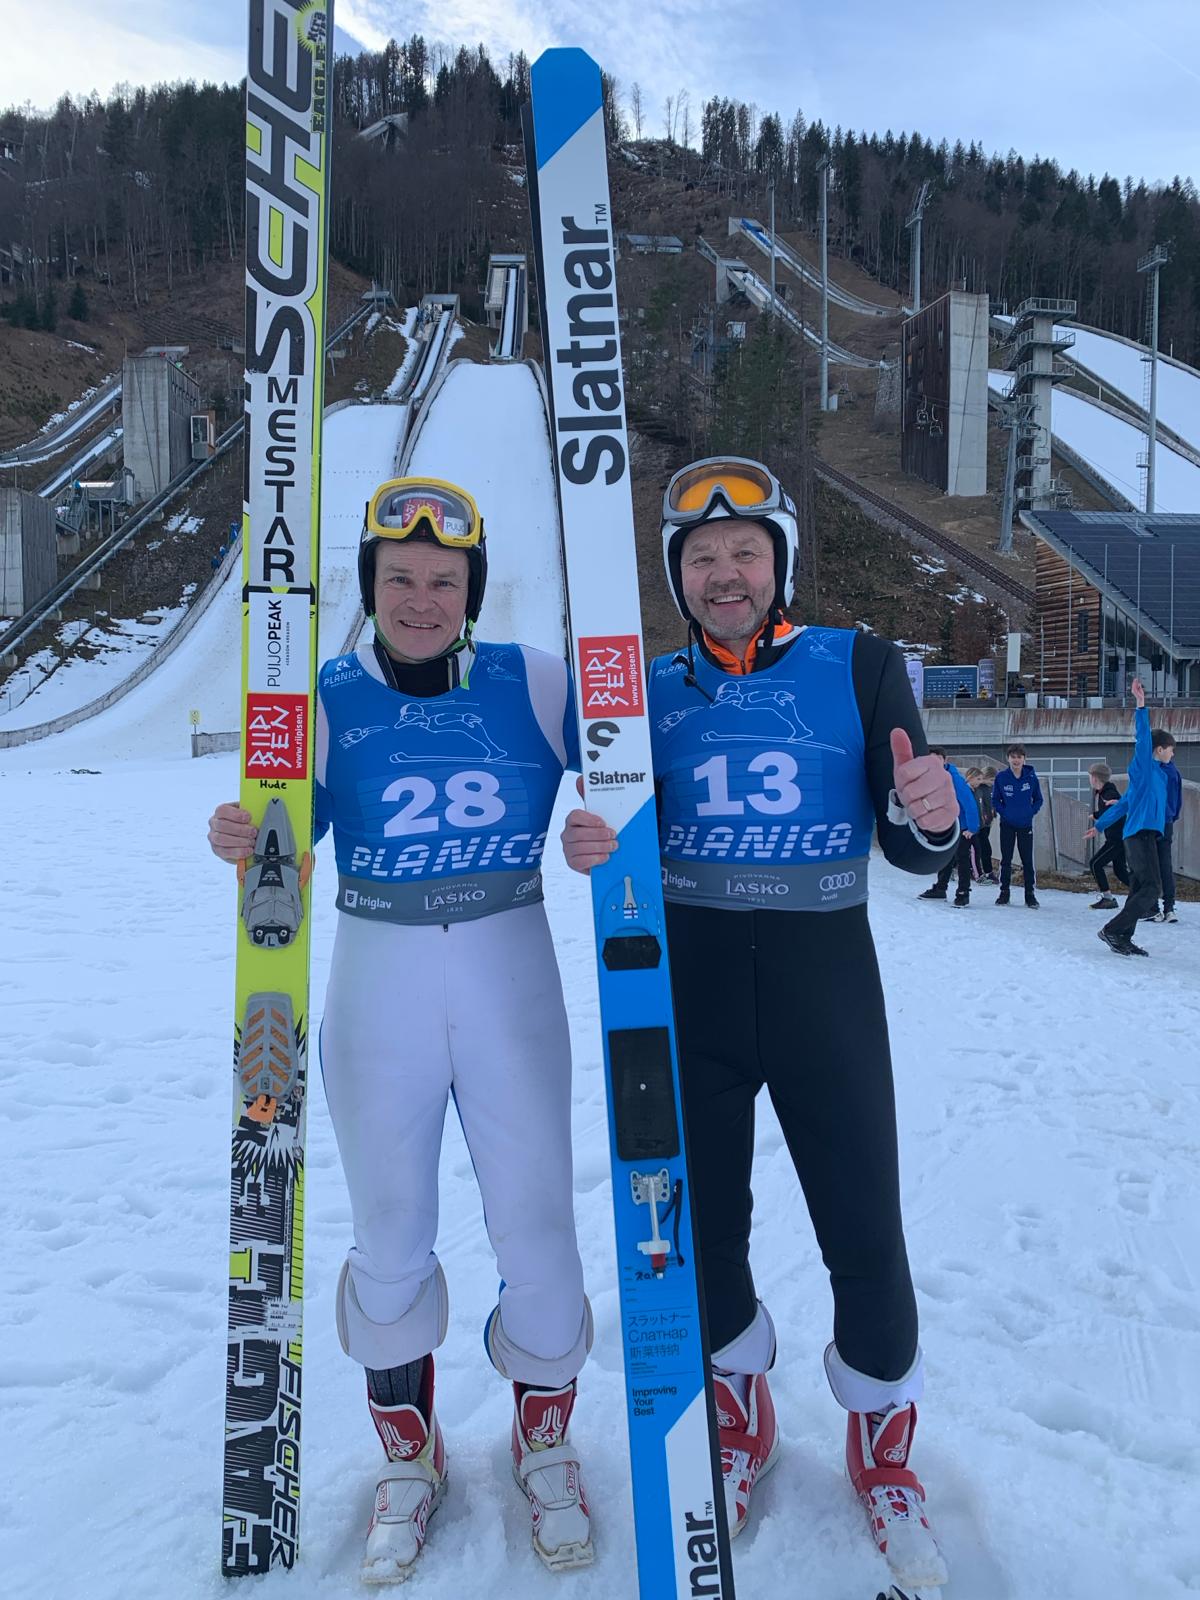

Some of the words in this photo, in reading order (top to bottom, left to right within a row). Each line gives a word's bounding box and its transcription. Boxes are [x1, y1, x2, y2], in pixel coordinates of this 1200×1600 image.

[312, 44, 326, 133] EAGLE
[557, 216, 625, 486] Slatnar
[263, 376, 298, 584] MESTAR
[267, 600, 281, 687] PUIJOPEAK
[323, 668, 363, 687] PLANICA
[585, 649, 610, 707] RIIPI
[627, 645, 639, 706] www.riipisen.fi
[248, 706, 273, 767] RIIPI
[294, 705, 304, 769] www.riipisen.fi
[260, 780, 287, 790] Hude
[589, 771, 646, 785] Slatnar
[693, 751, 801, 817] 13
[381, 770, 506, 838] 28
[664, 823, 853, 859] PLANICA
[359, 895, 392, 910] triglav
[668, 873, 698, 889] triglav
[821, 893, 838, 902] Audi
[628, 1312, 692, 1327] スラットナー
[628, 1327, 689, 1343] Слатнар
[632, 1384, 677, 1398] Improving
[633, 1407, 655, 1417] Best
[634, 1397, 654, 1406] Your
[270, 1357, 302, 1571] FISCHER
[684, 1511, 721, 1600] nar
